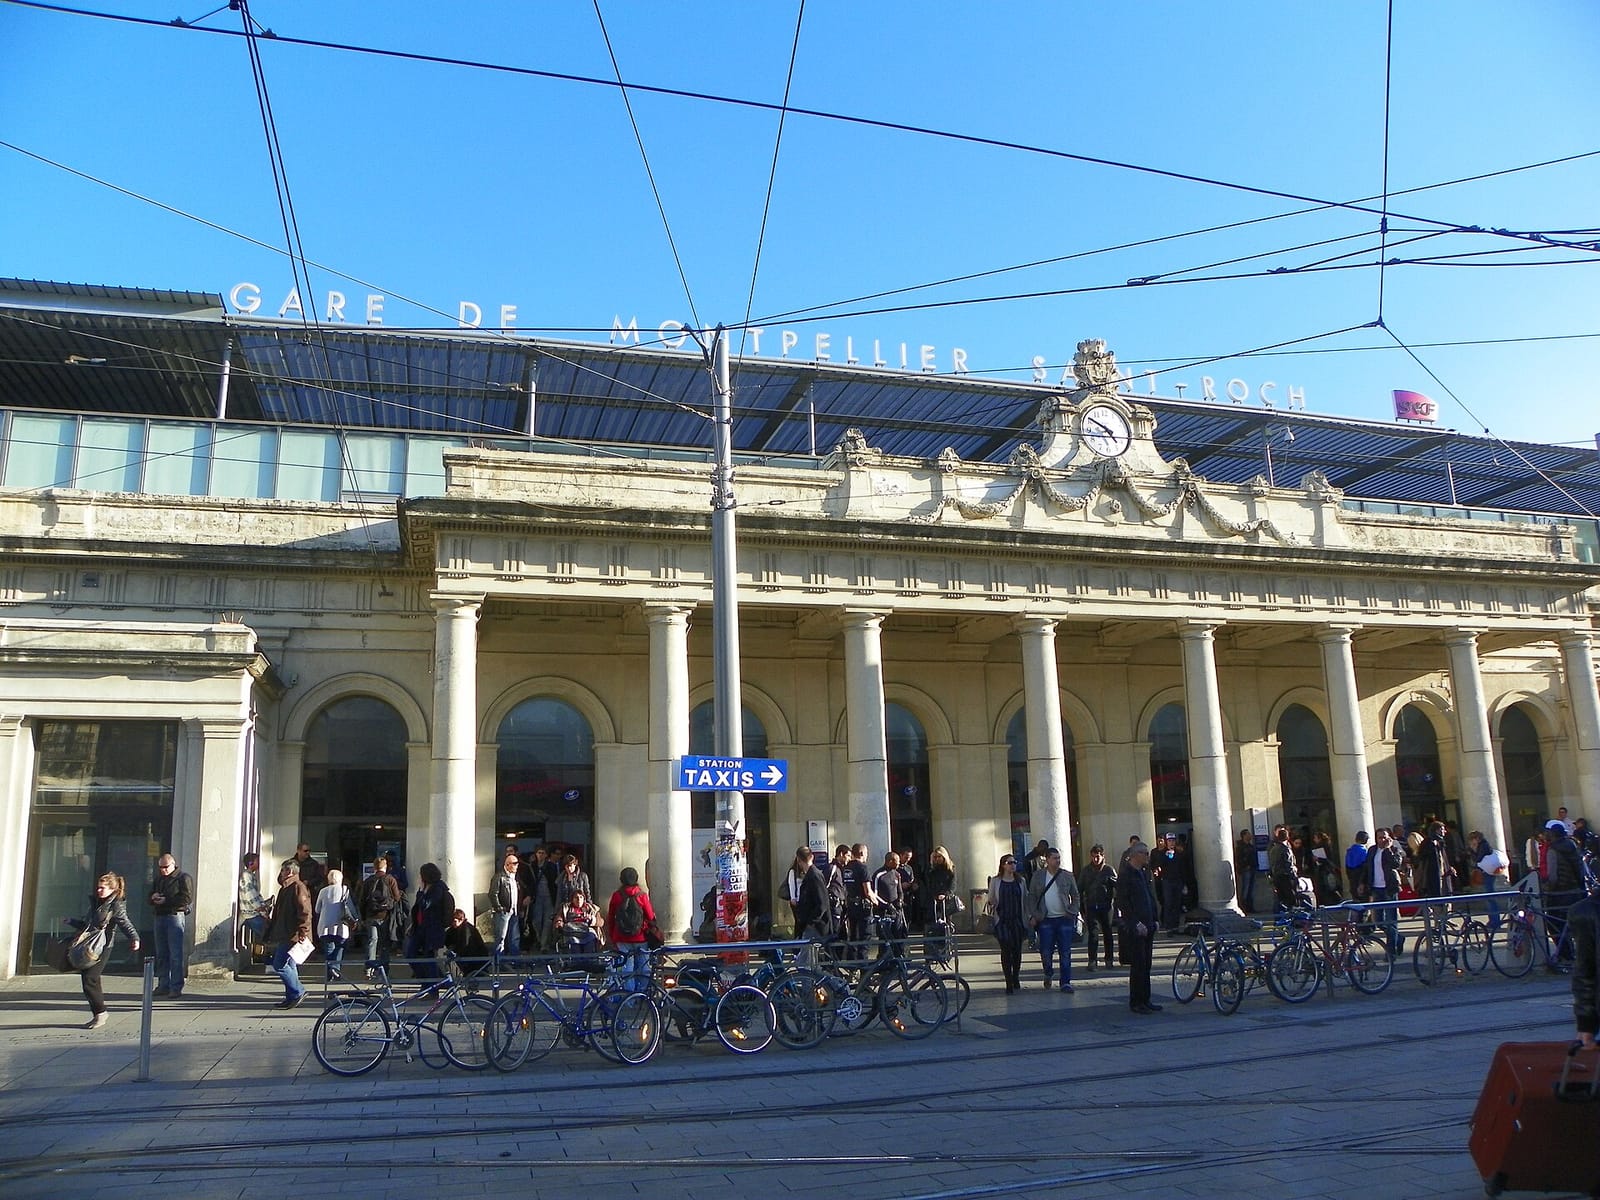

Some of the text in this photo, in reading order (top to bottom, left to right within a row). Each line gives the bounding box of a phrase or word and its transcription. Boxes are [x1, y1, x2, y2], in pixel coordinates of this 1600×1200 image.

[230, 282, 384, 323] GARE
[459, 301, 517, 333] DE
[699, 760, 742, 769] STATION
[685, 769, 754, 787] TAXIS
